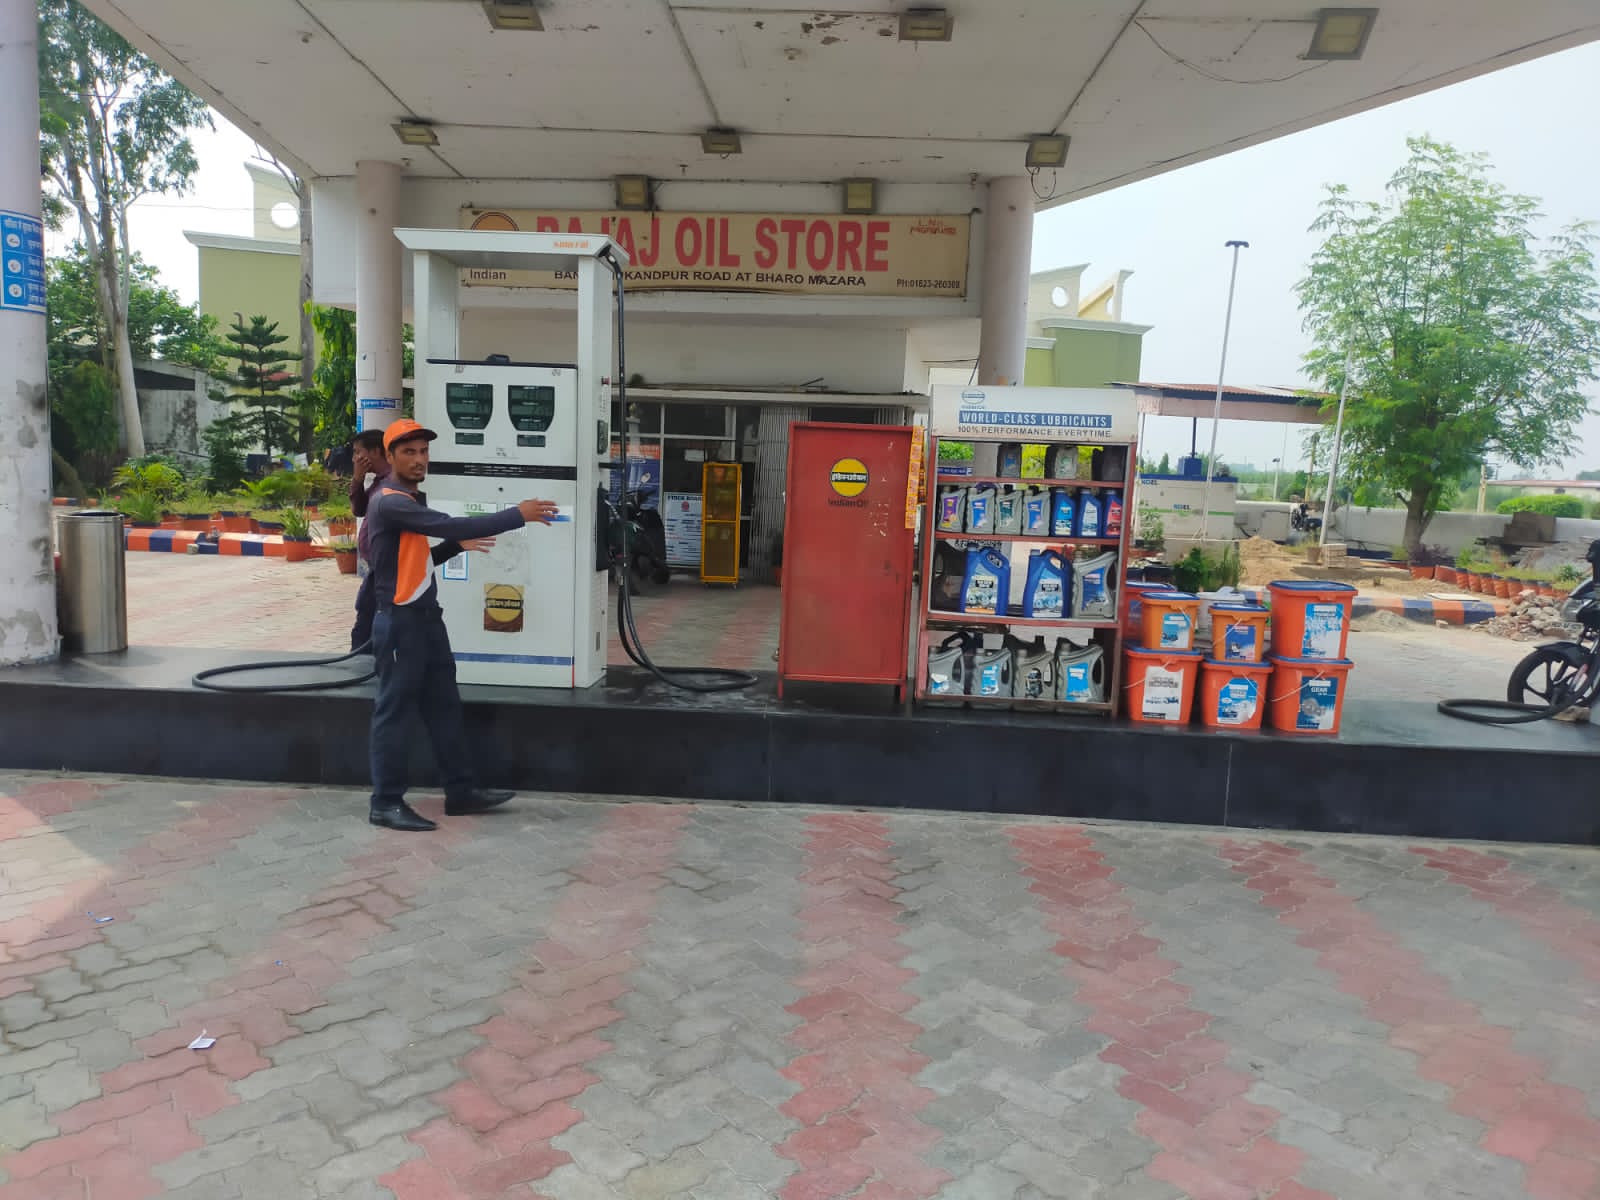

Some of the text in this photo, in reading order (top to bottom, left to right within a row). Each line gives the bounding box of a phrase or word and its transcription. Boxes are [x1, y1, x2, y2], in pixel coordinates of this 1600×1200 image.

[674, 216, 741, 268] OIL
[753, 217, 891, 273] STORE
[469, 269, 507, 281] Indian
[612, 271, 689, 281] KANDPUR
[692, 271, 732, 281] ROAD
[734, 272, 752, 282] AT
[755, 272, 804, 284] BHARO
[808, 275, 866, 287] MAZARA
[962, 412, 1107, 427] WORLD-CLASS LUBRICANTS
